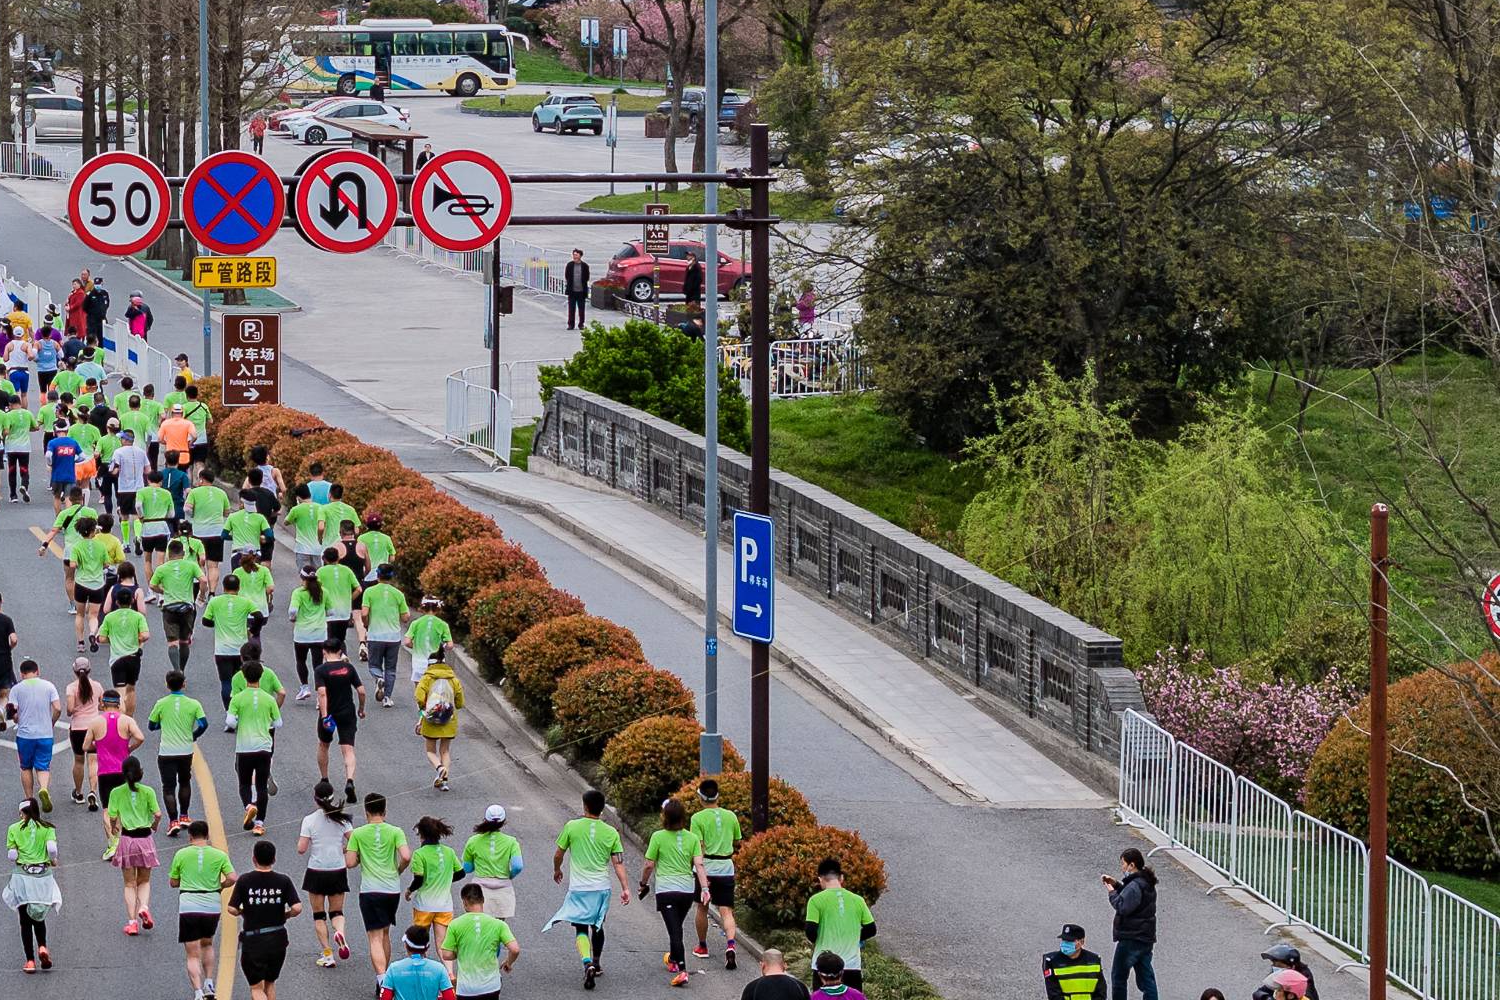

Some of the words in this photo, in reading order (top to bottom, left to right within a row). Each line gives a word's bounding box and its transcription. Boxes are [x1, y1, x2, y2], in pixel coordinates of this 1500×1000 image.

[90, 181, 152, 227] 50
[198, 261, 271, 284] 严管路段
[244, 322, 256, 337] P
[229, 347, 275, 361] 停车场
[237, 363, 266, 376] 入口
[741, 536, 758, 583] P
[749, 574, 768, 589] 停车场
